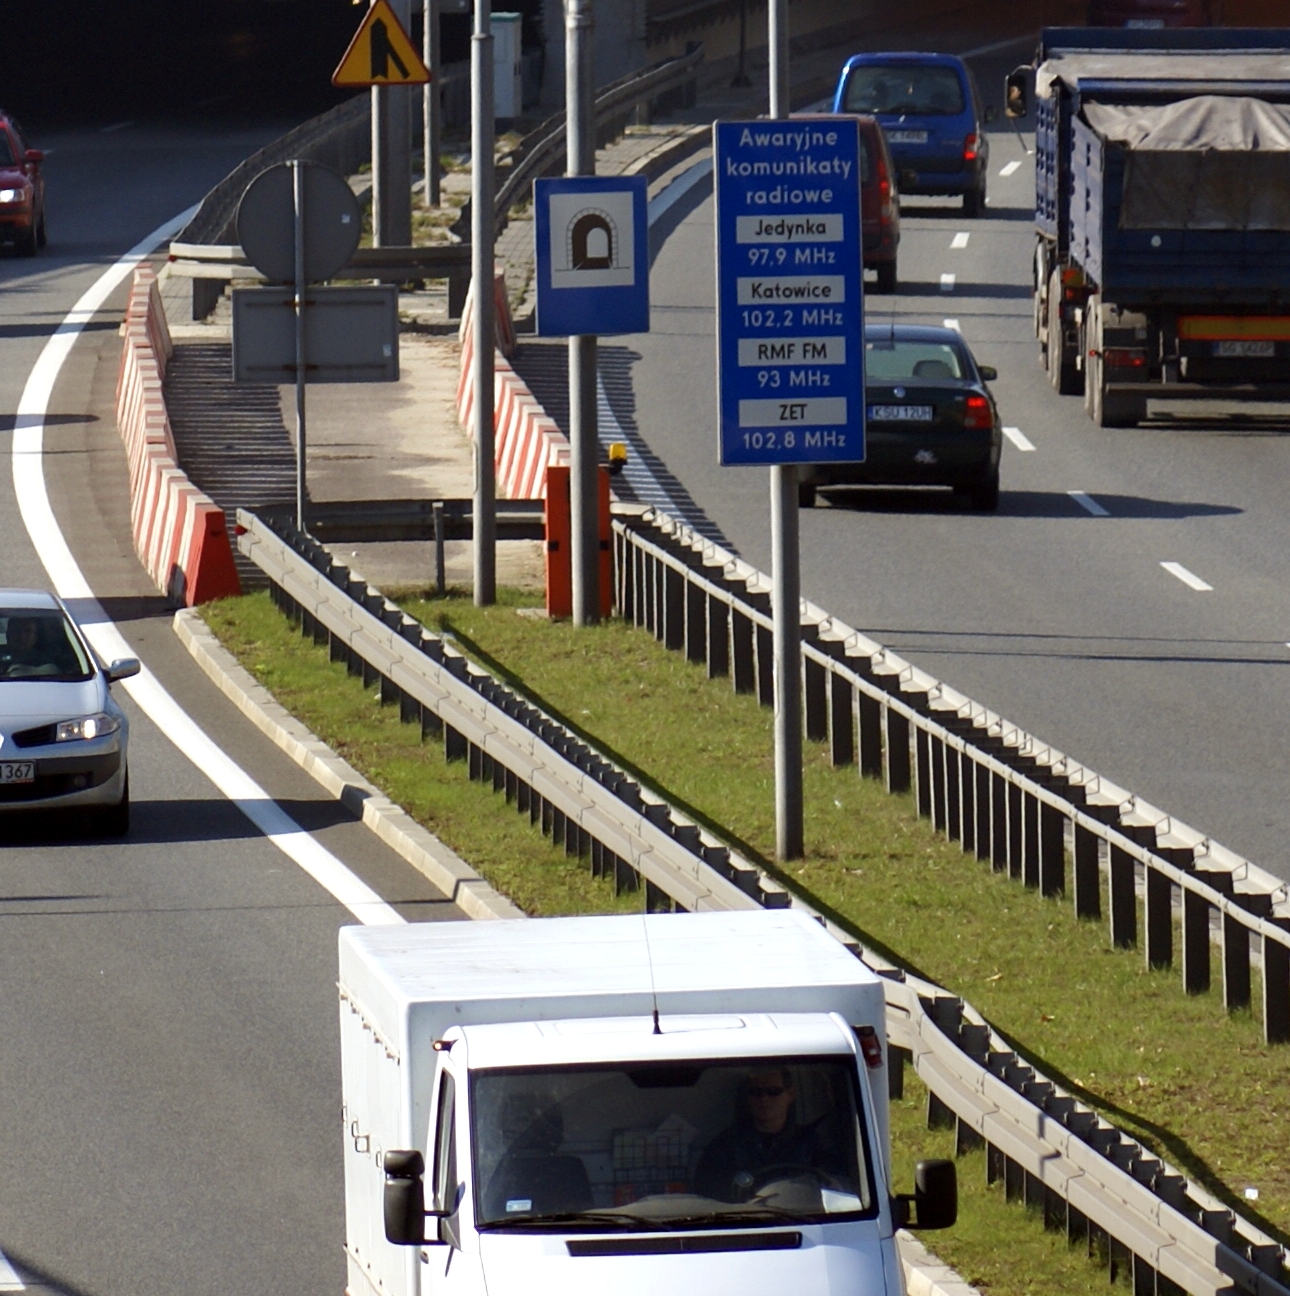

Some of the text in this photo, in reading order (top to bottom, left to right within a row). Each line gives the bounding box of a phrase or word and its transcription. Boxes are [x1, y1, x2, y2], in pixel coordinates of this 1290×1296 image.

[739, 127, 838, 151] Awaryjne
[726, 156, 852, 180] komunikaty
[746, 185, 833, 204] radiowe
[755, 219, 826, 240] Jedynka
[748, 247, 836, 266] 97,9 MHz
[751, 281, 831, 299] Katowice
[742, 309, 843, 328] 102,2 MHz
[758, 343, 827, 360] RMF FM
[758, 370, 831, 388] 93 MHz
[779, 403, 807, 420] ZET
[743, 430, 846, 450] 102,8 MHz
